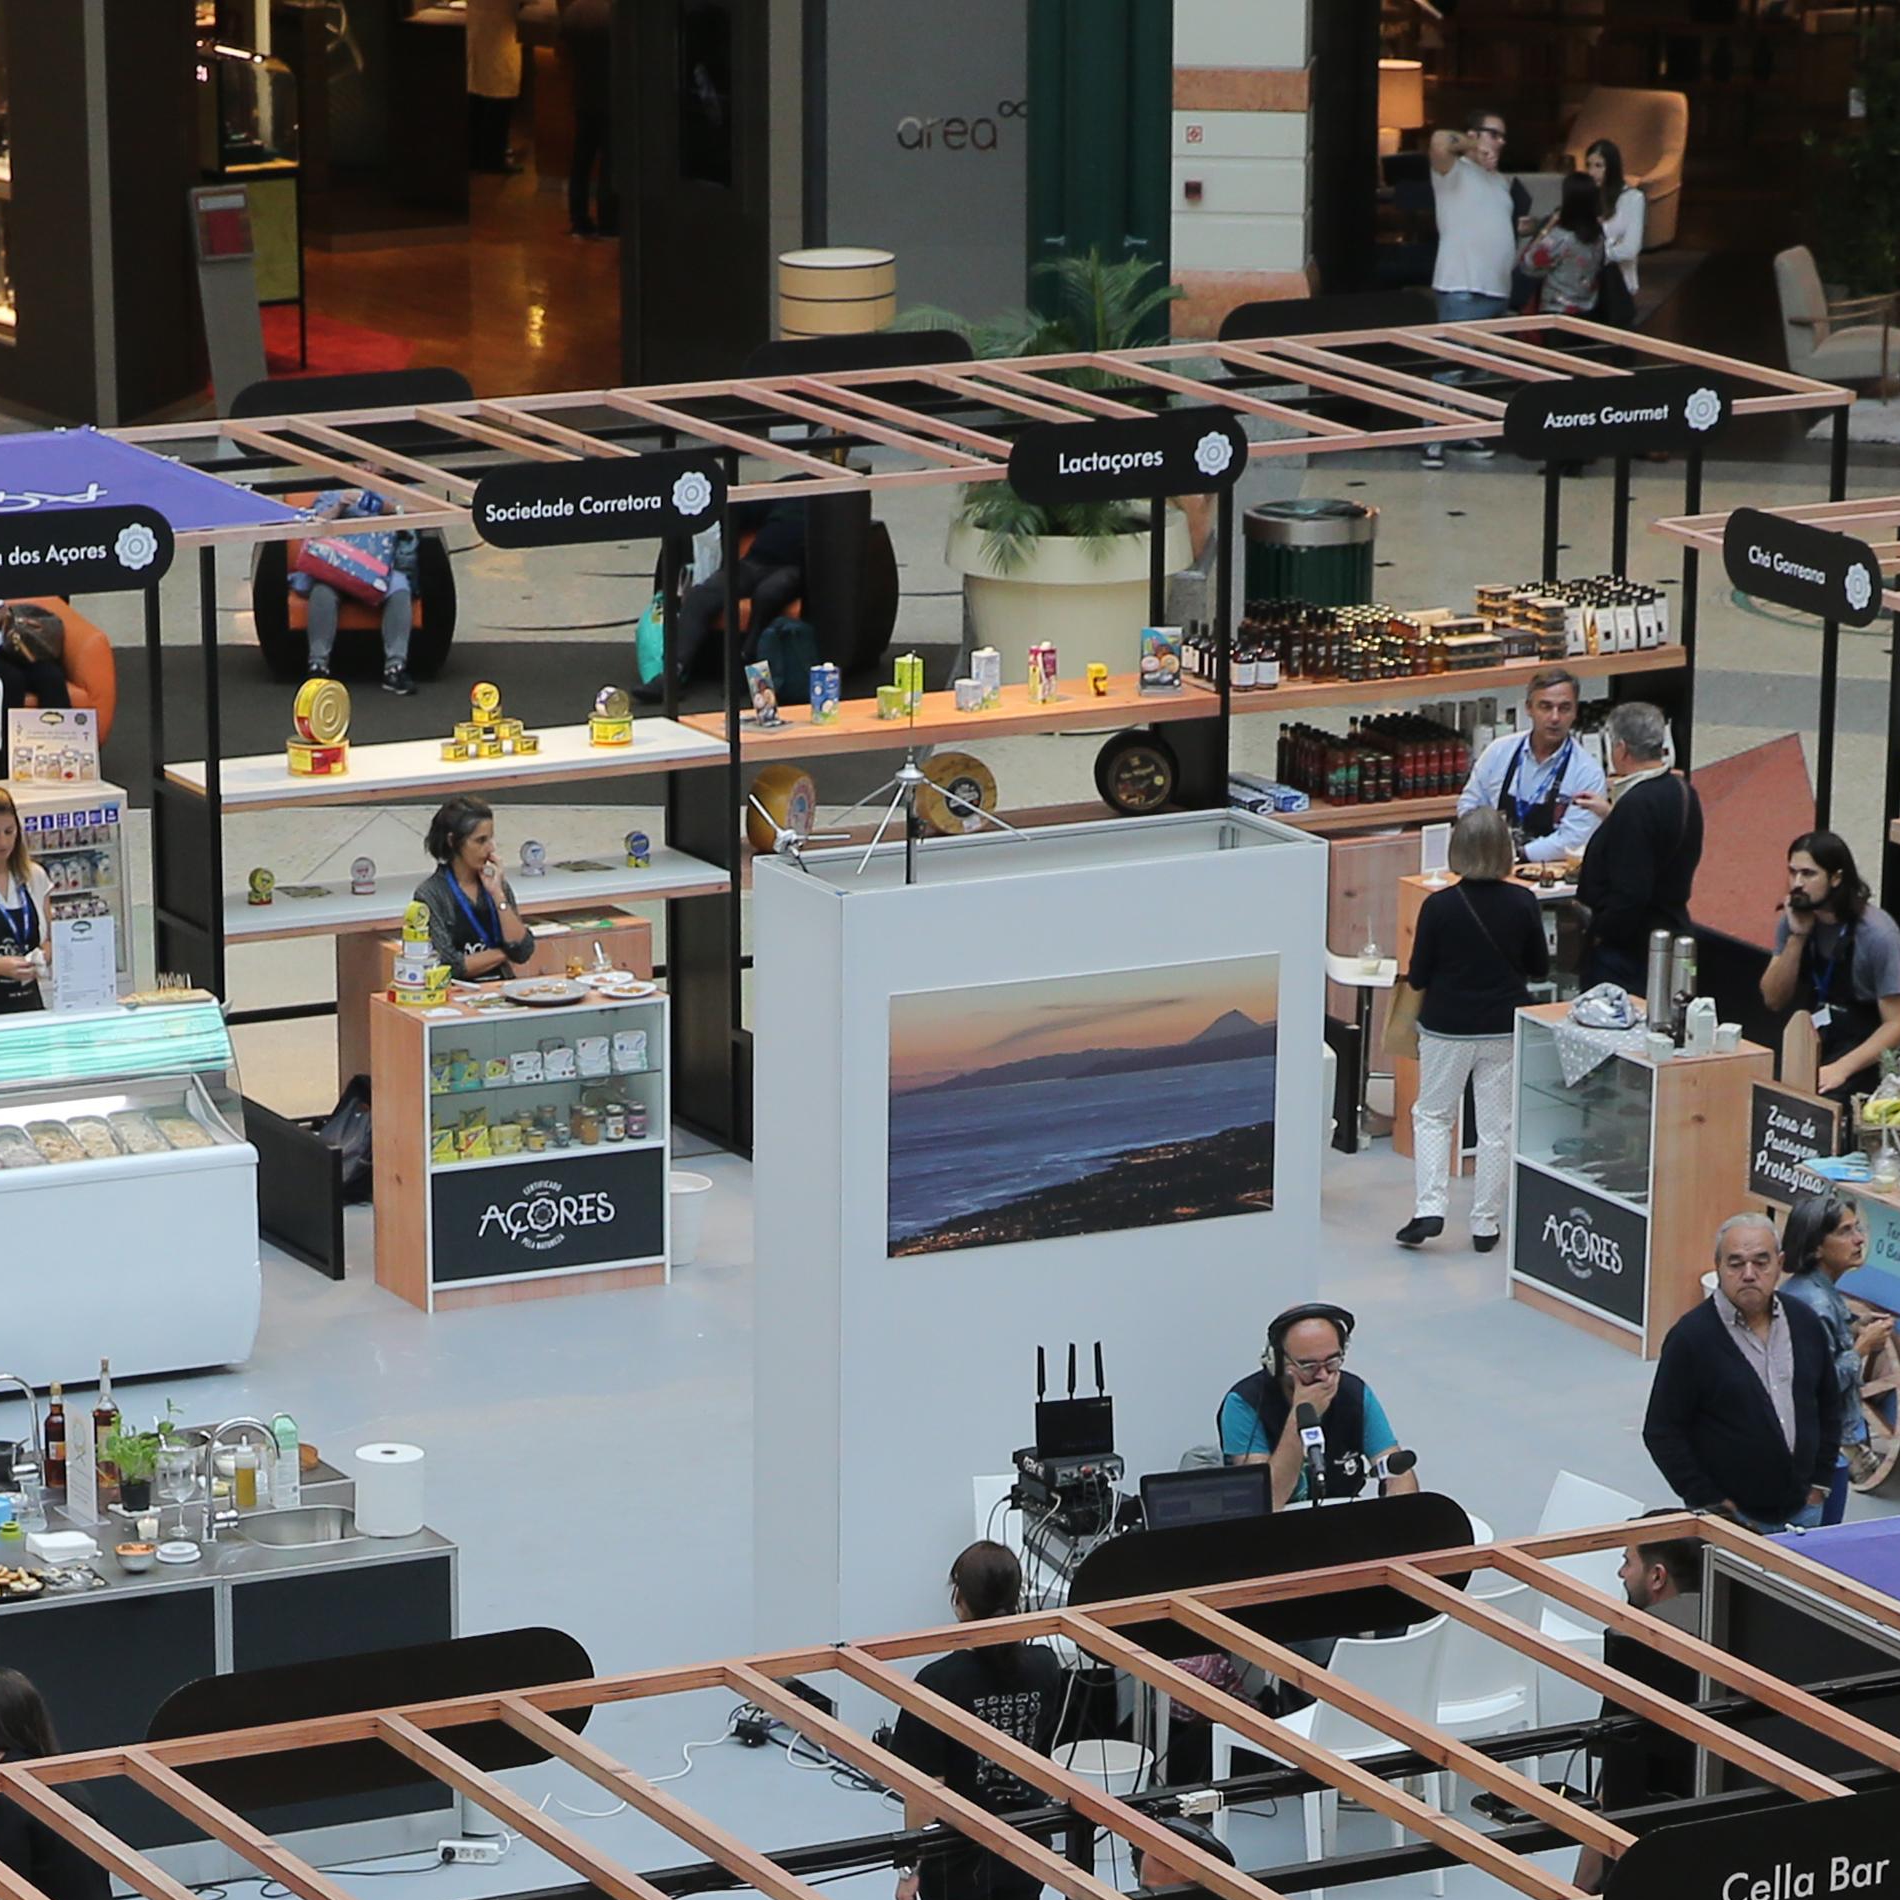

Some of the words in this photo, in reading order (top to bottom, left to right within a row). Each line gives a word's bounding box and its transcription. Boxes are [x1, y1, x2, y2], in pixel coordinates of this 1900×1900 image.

[897, 116, 996, 152] area
[1544, 408, 1595, 429] Azores
[1600, 405, 1669, 426] Gourmet
[1059, 451, 1164, 475] Lactaçores
[485, 501, 574, 522] Sociedade
[578, 492, 662, 515] Corretora
[8, 547, 41, 566] dos
[45, 541, 107, 566] Açores
[1748, 545, 1771, 568] Chá
[1773, 550, 1826, 584] Gorreana
[1768, 1105, 1799, 1133] Zona
[1800, 1117, 1816, 1139] de
[478, 1191, 615, 1240] AÇORES
[1542, 1214, 1623, 1275] AÇORES
[1828, 1855, 1891, 1892] Bar
